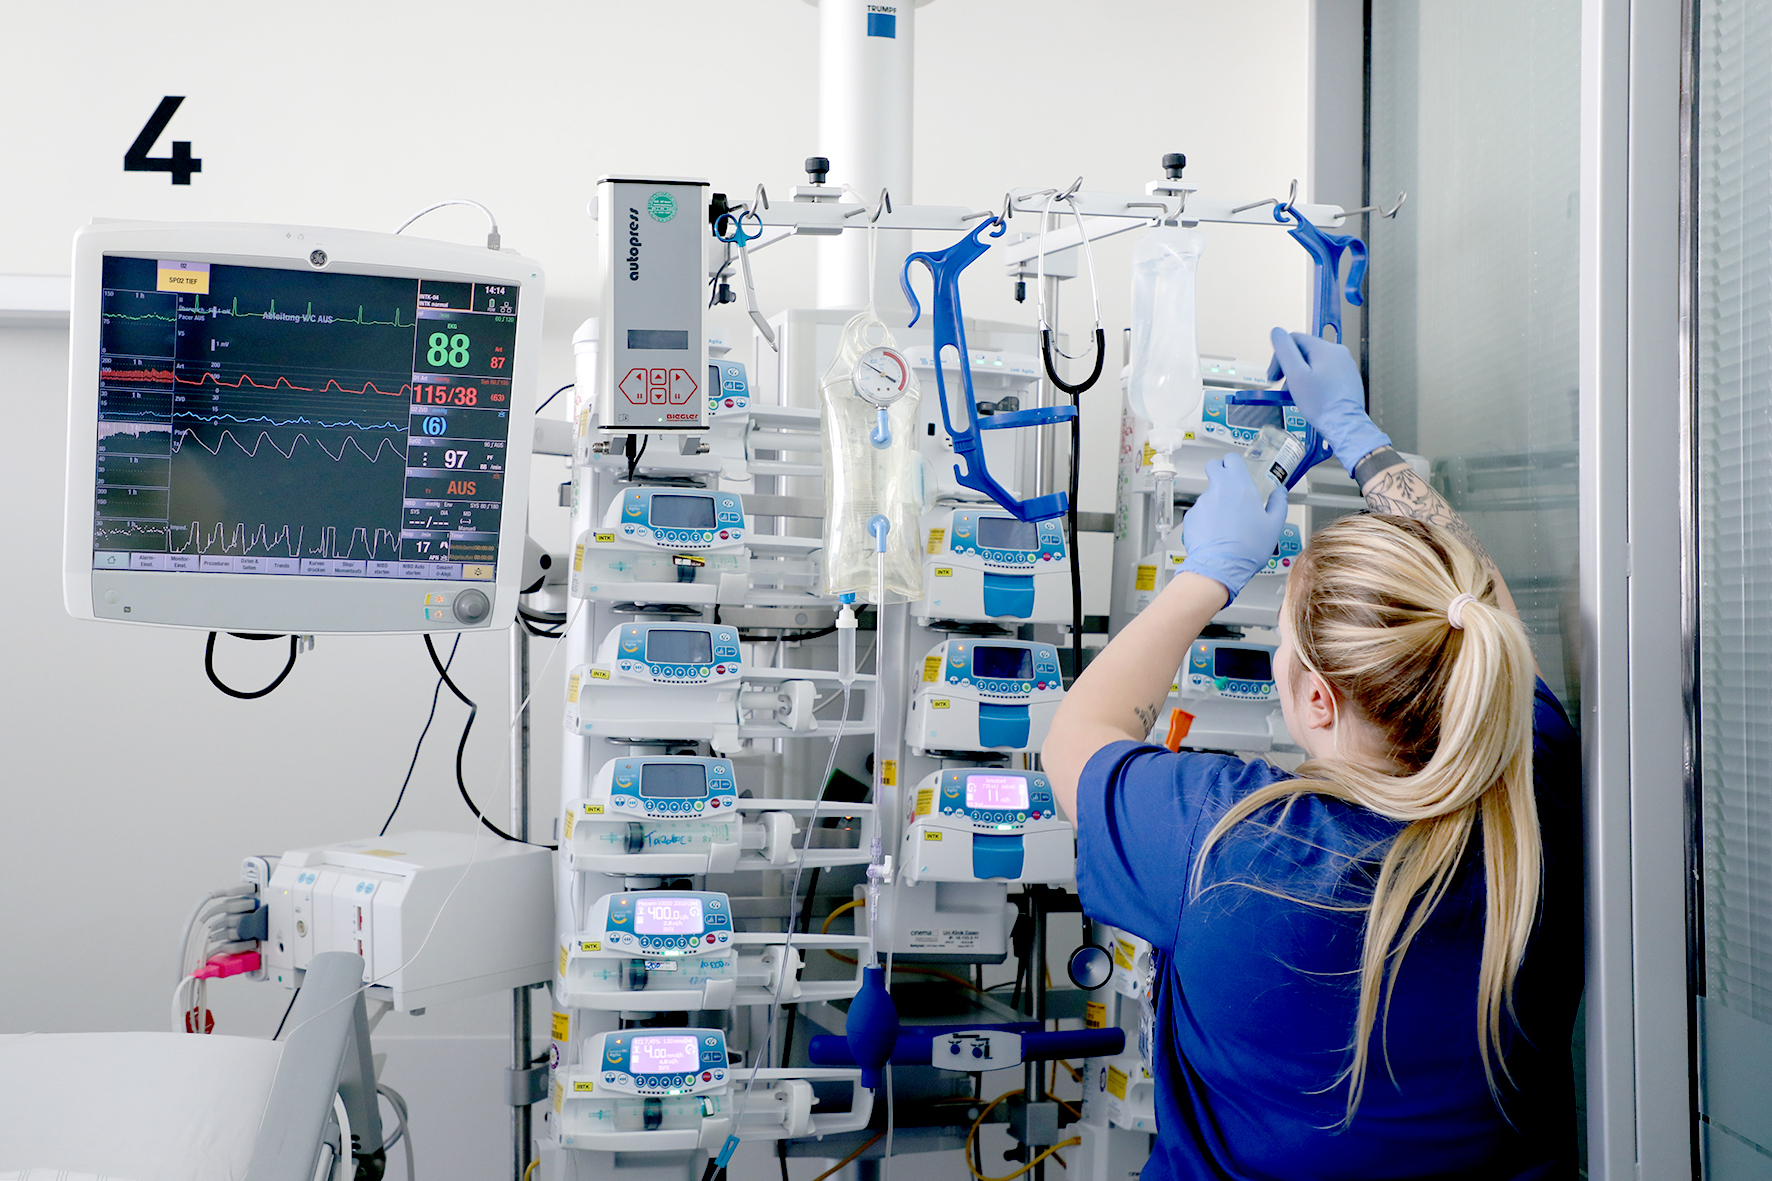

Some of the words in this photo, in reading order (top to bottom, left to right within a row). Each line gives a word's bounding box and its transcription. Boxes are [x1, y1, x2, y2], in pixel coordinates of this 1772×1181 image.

[867, 5, 896, 13] TRUMPF
[124, 96, 202, 185] 4
[626, 207, 642, 281] autopress
[485, 285, 506, 295] 14:14
[317, 315, 333, 324] AUS
[426, 332, 471, 369] 88
[490, 356, 506, 369] 87
[414, 384, 478, 406] 115/38
[422, 416, 447, 436] (6)
[444, 449, 469, 469] 97
[447, 480, 477, 495] AUS
[416, 541, 431, 553] 17
[648, 906, 680, 920] 400.0
[644, 1045, 667, 1059] 4.00
